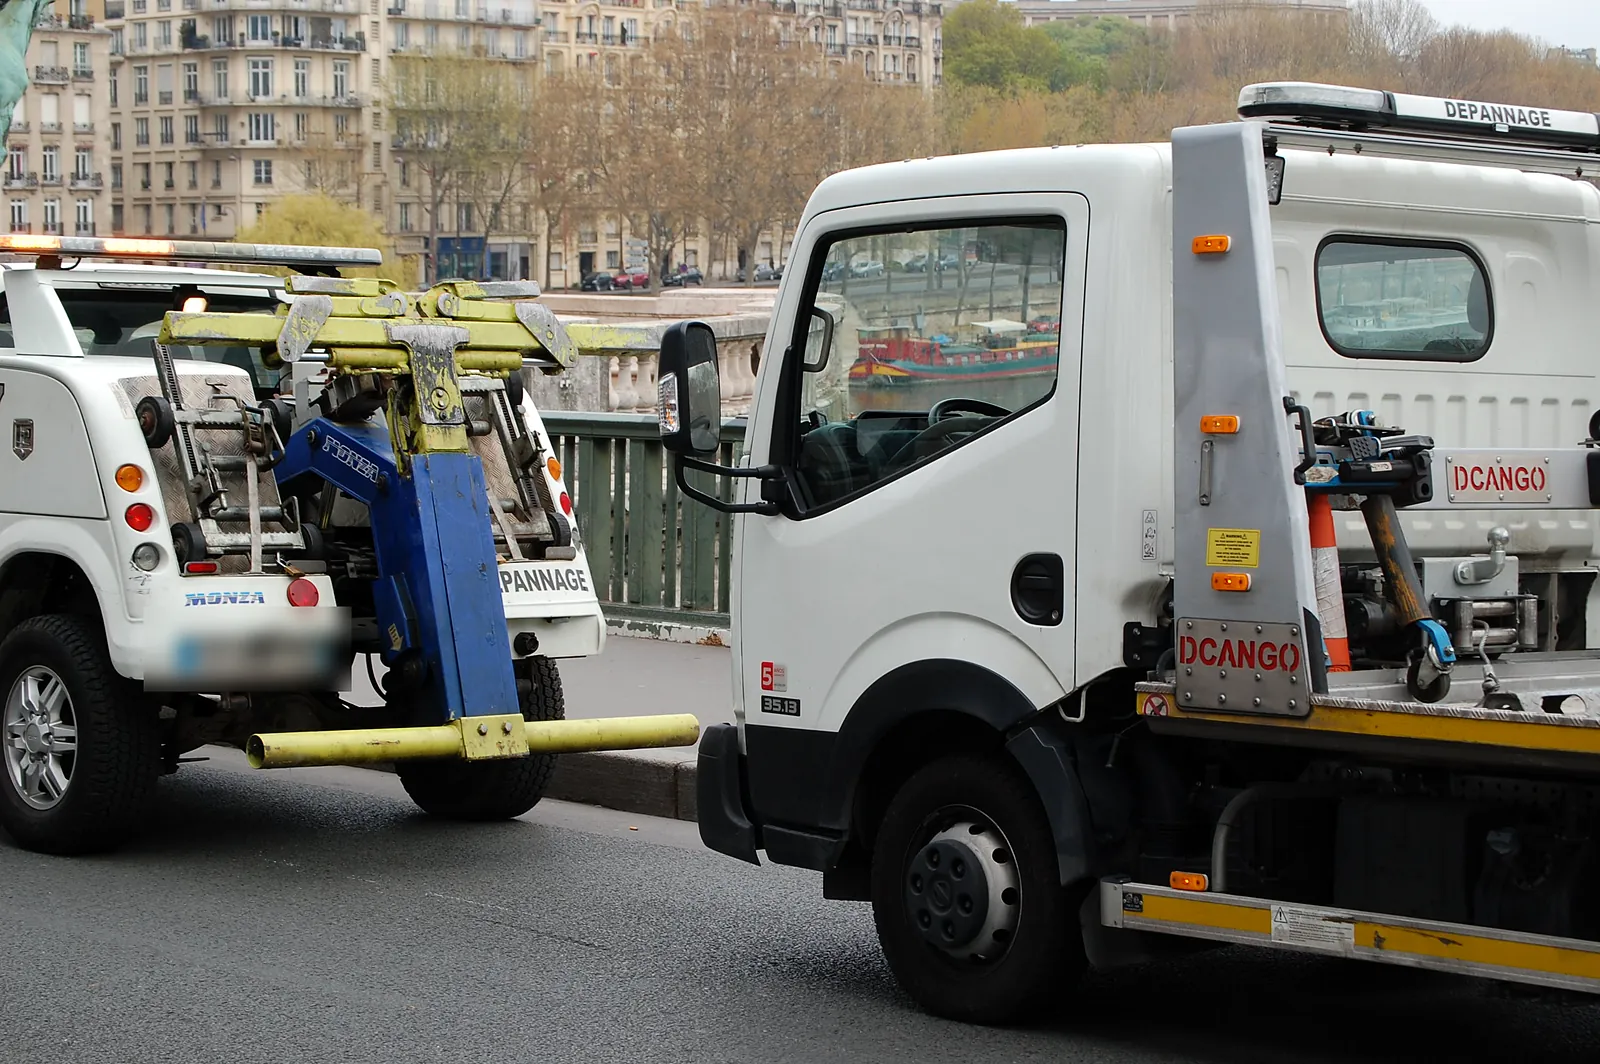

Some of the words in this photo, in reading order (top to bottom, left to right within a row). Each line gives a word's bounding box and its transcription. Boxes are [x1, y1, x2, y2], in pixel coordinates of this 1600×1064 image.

[1444, 101, 1551, 127] DEPANNAGE
[322, 434, 379, 484] MONZA
[1454, 466, 1545, 491] DCANGO
[499, 568, 589, 593] PANNAGE
[185, 591, 265, 607] MONZA
[1180, 635, 1299, 673] DCANGO
[763, 667, 772, 686] 5
[764, 697, 797, 714] 35.13
